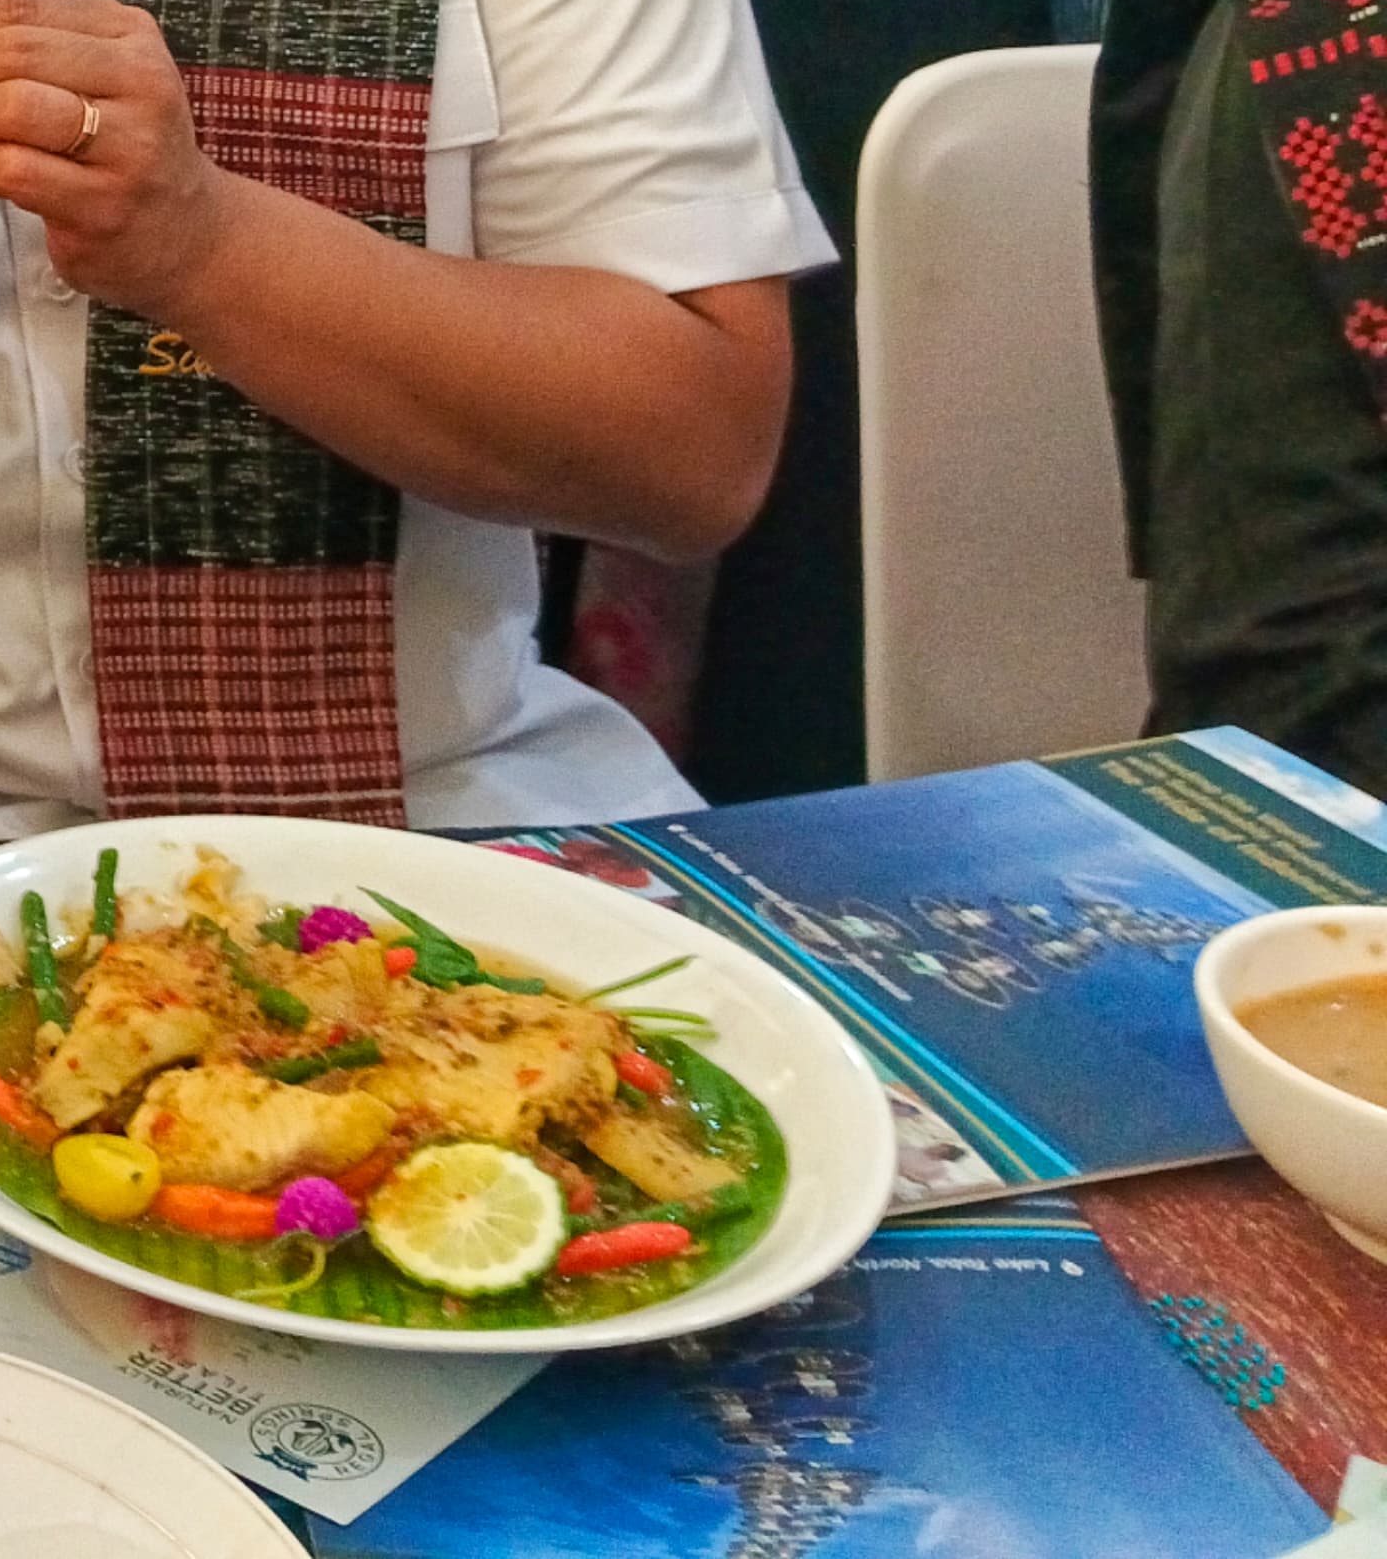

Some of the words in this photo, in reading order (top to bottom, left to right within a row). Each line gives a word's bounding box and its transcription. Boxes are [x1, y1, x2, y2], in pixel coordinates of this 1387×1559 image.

[993, 1257, 1050, 1272] Lake
[115, 1365, 237, 1425] NATURALLY
[128, 1349, 257, 1417] BETTER
[255, 1406, 354, 1438] SPRINGS
[333, 1431, 377, 1476] REGAL
